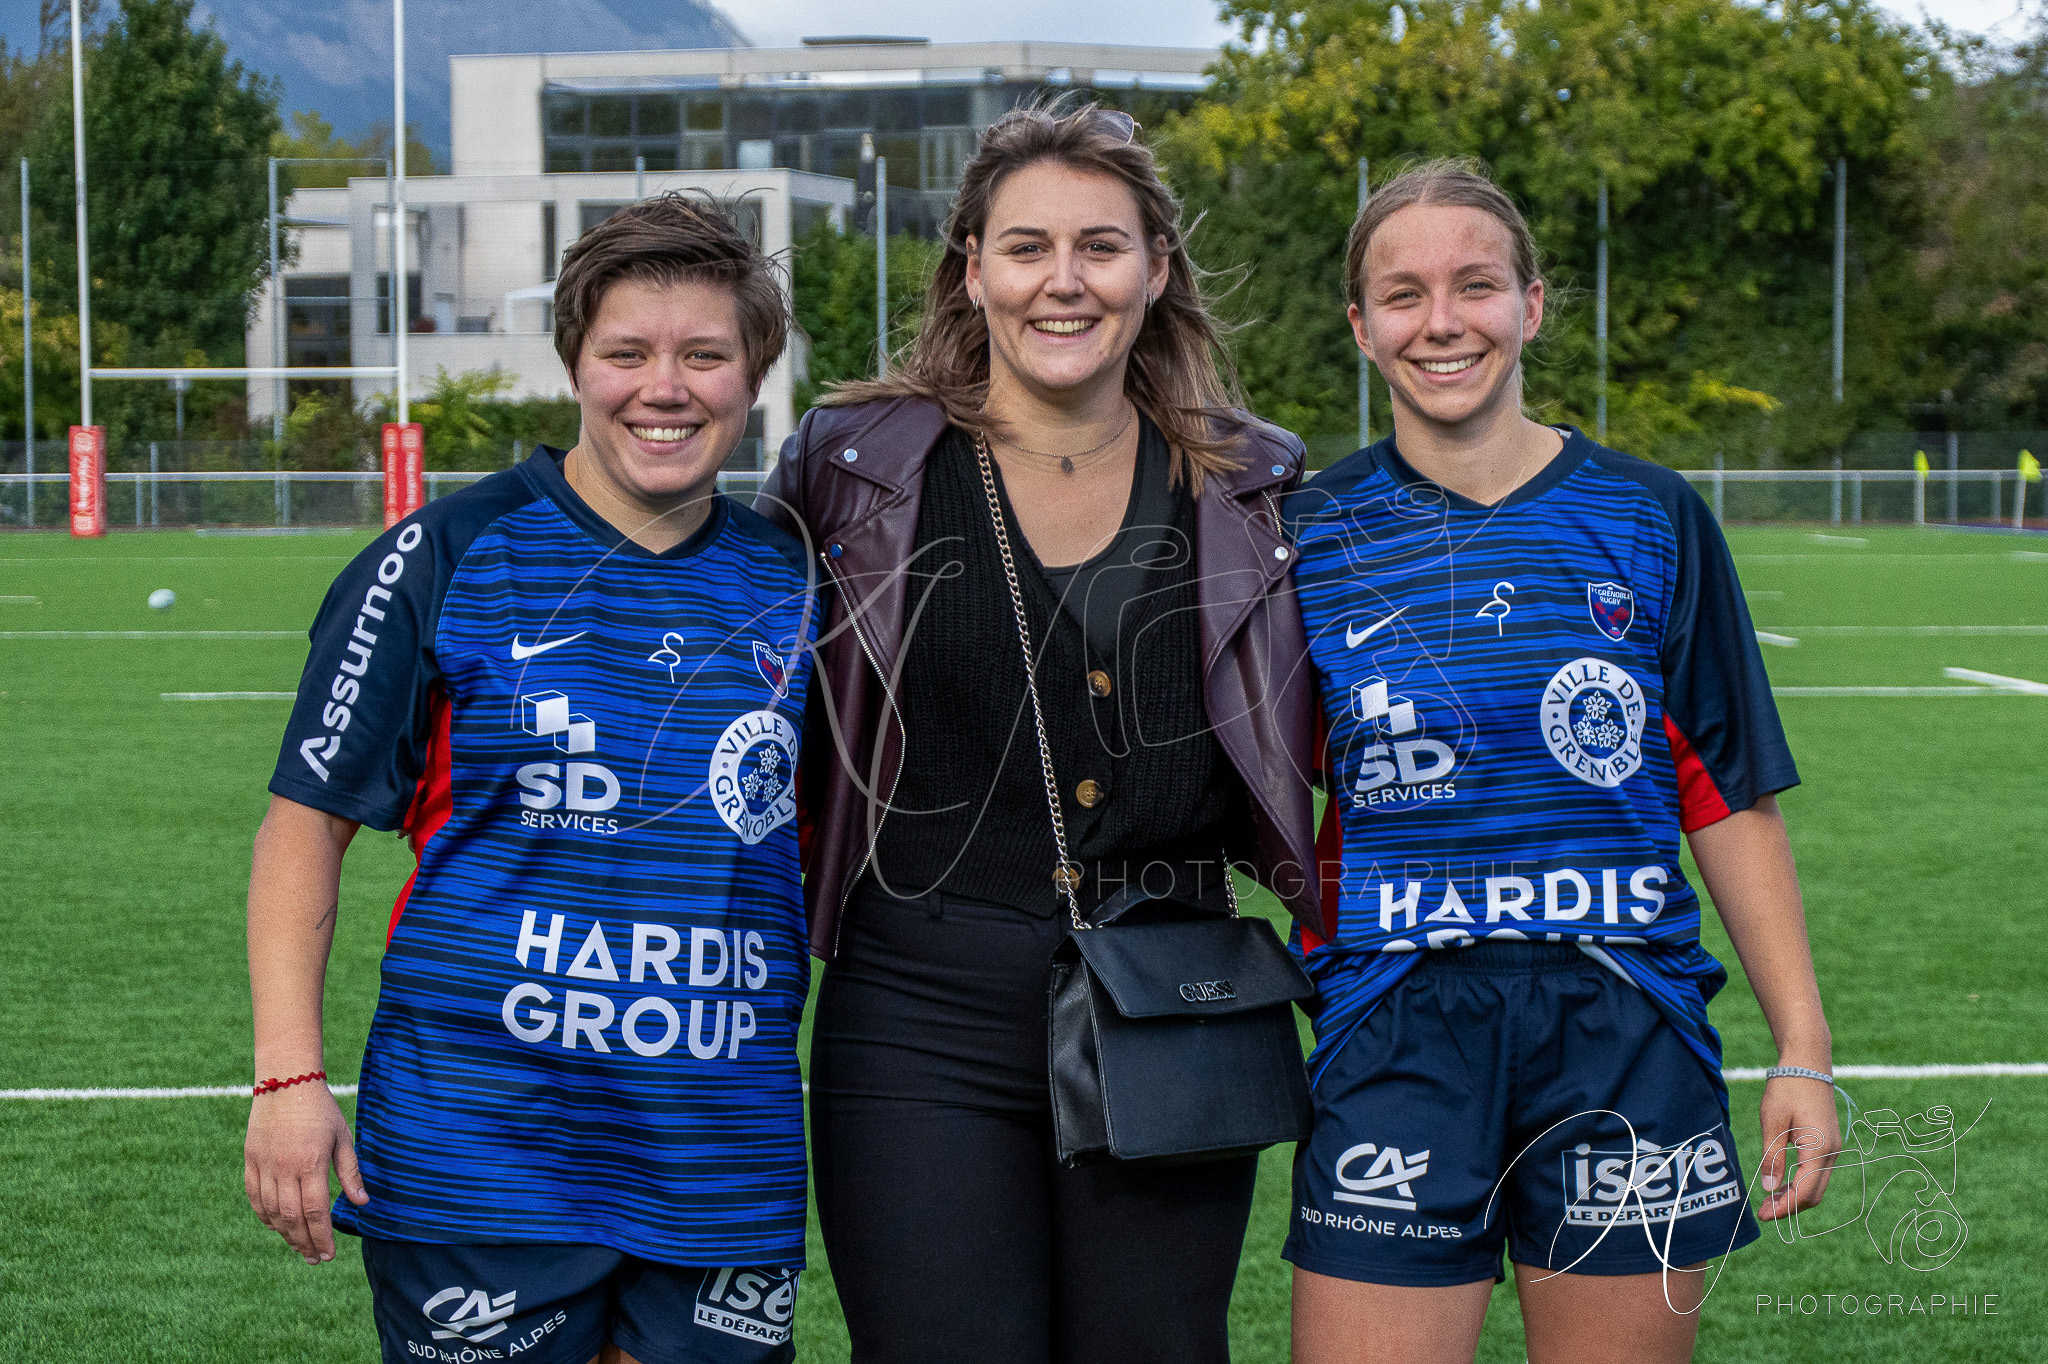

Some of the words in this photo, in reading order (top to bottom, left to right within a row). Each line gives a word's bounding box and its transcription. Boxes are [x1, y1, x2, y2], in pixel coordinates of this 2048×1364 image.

[1599, 596, 1621, 606] RUGBY
[300, 522, 422, 782] Assurnoo
[1547, 664, 1611, 705] VILLE
[1617, 678, 1641, 717] DE
[720, 717, 783, 755] VILLE
[1549, 724, 1640, 782] GRENBLE
[516, 762, 621, 812] SD
[1354, 738, 1456, 792] SD
[1353, 783, 1456, 809] SERVICES
[520, 810, 618, 835] SERVICES
[1379, 866, 1668, 932] HARDIS
[514, 909, 768, 990] HARDIS
[1179, 979, 1237, 1002] GUESS
[502, 982, 757, 1060] GROUP
[1575, 1138, 1729, 1202] isère
[1301, 1206, 1322, 1224] SUD
[1325, 1214, 1396, 1236] RHÔNE
[1401, 1224, 1463, 1239] ALPES
[1569, 1209, 1593, 1221] LE
[407, 1340, 437, 1359] SUD
[509, 1310, 567, 1357] ALPES
[698, 1309, 718, 1325] LE
